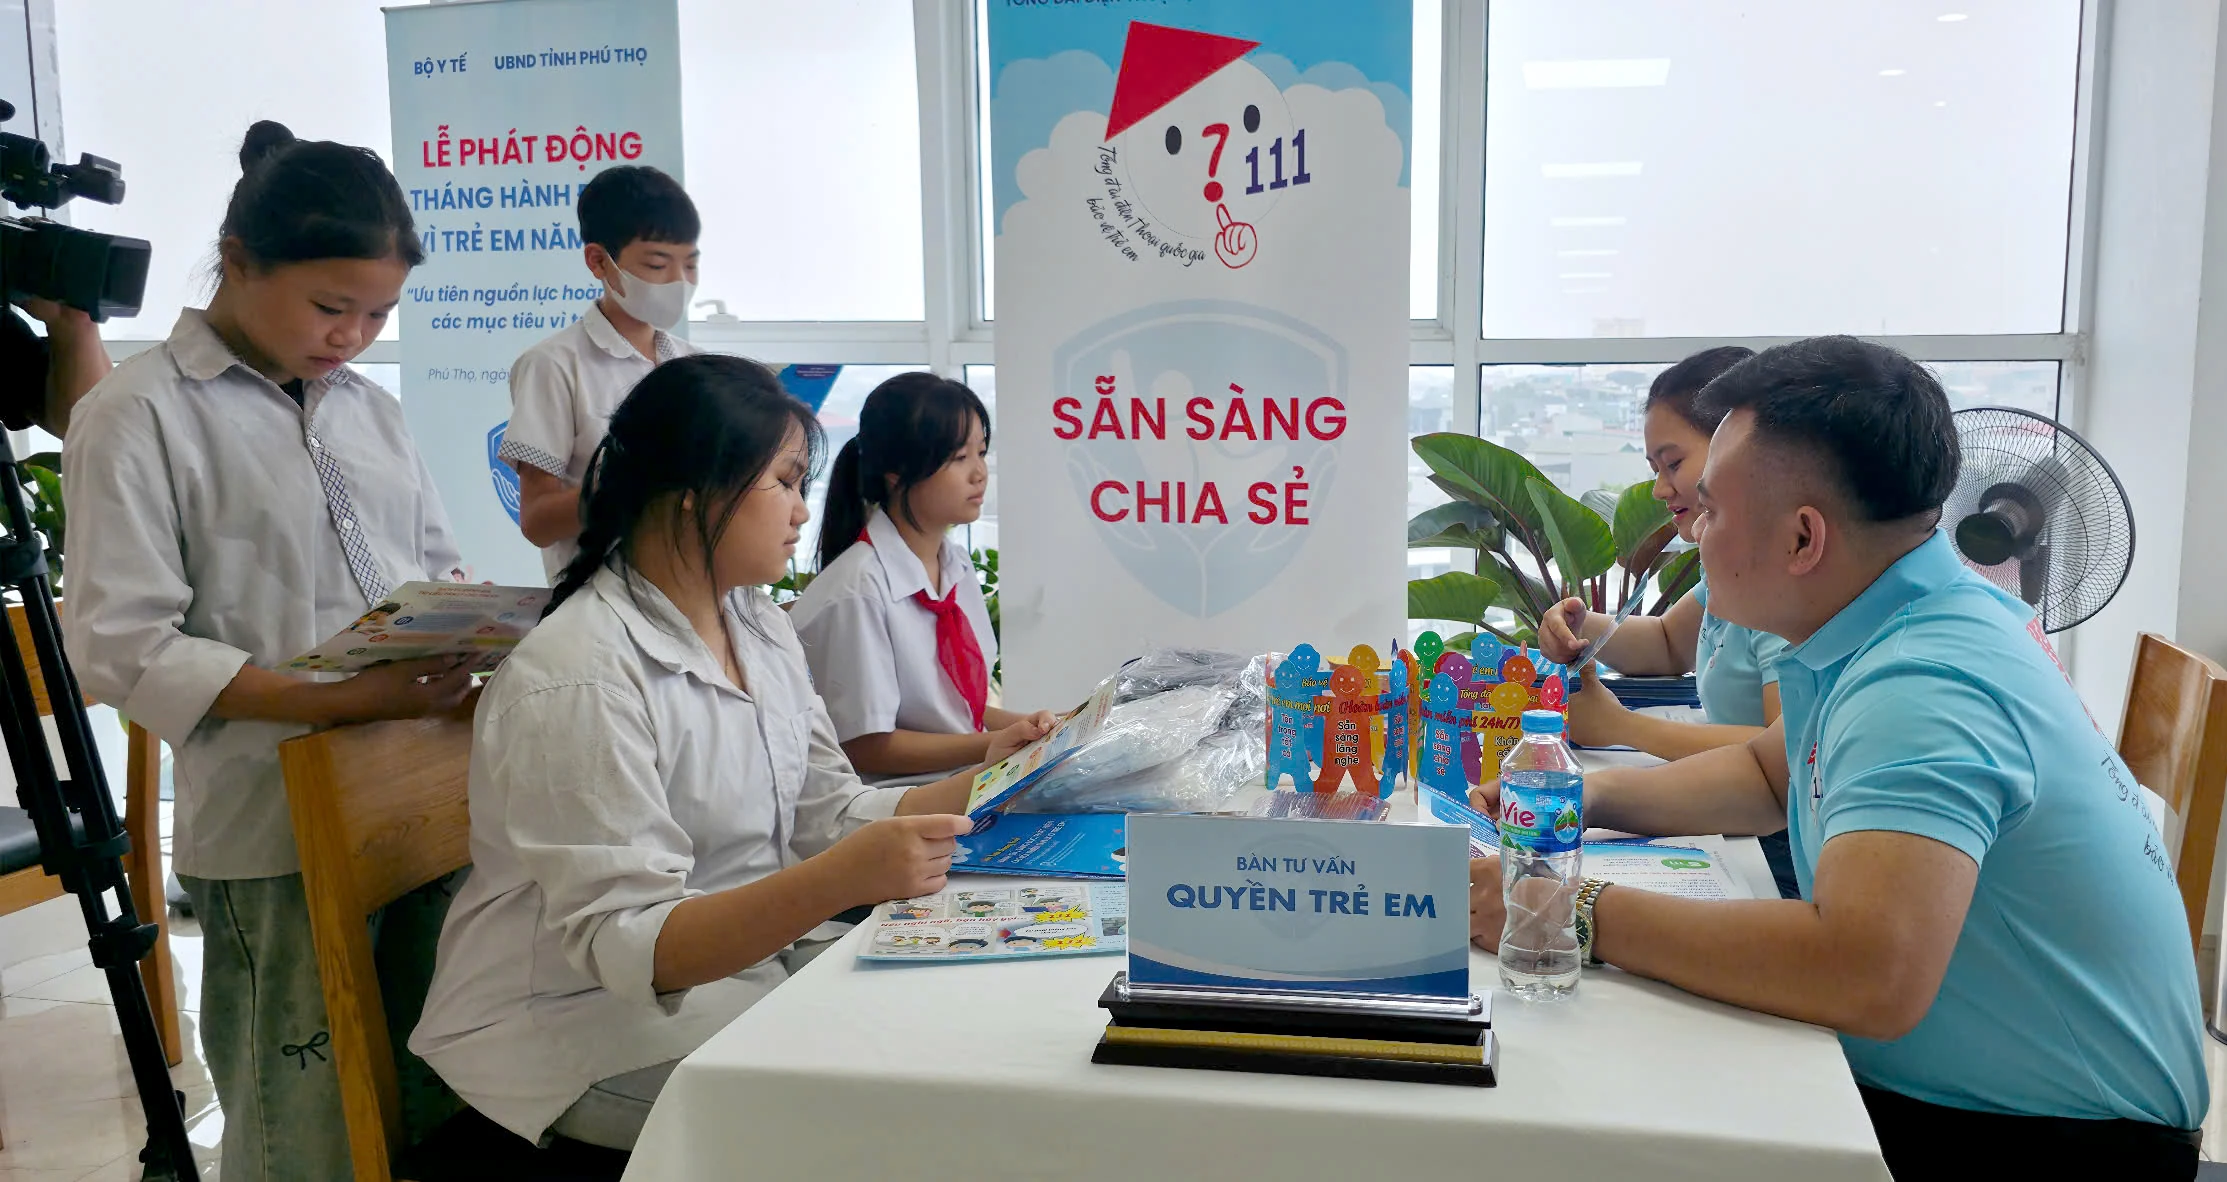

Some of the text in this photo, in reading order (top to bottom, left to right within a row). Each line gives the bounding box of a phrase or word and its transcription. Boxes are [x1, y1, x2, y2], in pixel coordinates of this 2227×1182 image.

[414, 52, 468, 79] BỘ Y TẾ
[494, 45, 648, 70] UBND TỈNH PHÚ THỌ
[423, 124, 644, 172] LỄ PHÁT ĐỘNG
[1245, 128, 1311, 195] 111
[410, 181, 494, 211] THÁNG
[500, 179, 571, 208] HÀNH
[441, 222, 483, 252] TRẺ
[490, 229, 524, 252] EM
[438, 285, 469, 302] tiên
[473, 282, 529, 306] nguồn
[533, 285, 558, 305] lực
[431, 314, 461, 330] các
[467, 315, 507, 333] mục
[513, 311, 545, 329] tiêu
[550, 311, 566, 329] vì
[428, 367, 450, 381] Phú
[1052, 375, 1347, 441] SẴN SÀNG
[1090, 465, 1310, 525] CHIA SẺ
[1334, 756, 1359, 768] nghe
[1236, 853, 1356, 876] BÀN TƯ VẤN
[1166, 878, 1437, 919] QUYỀN TRẺ EM
